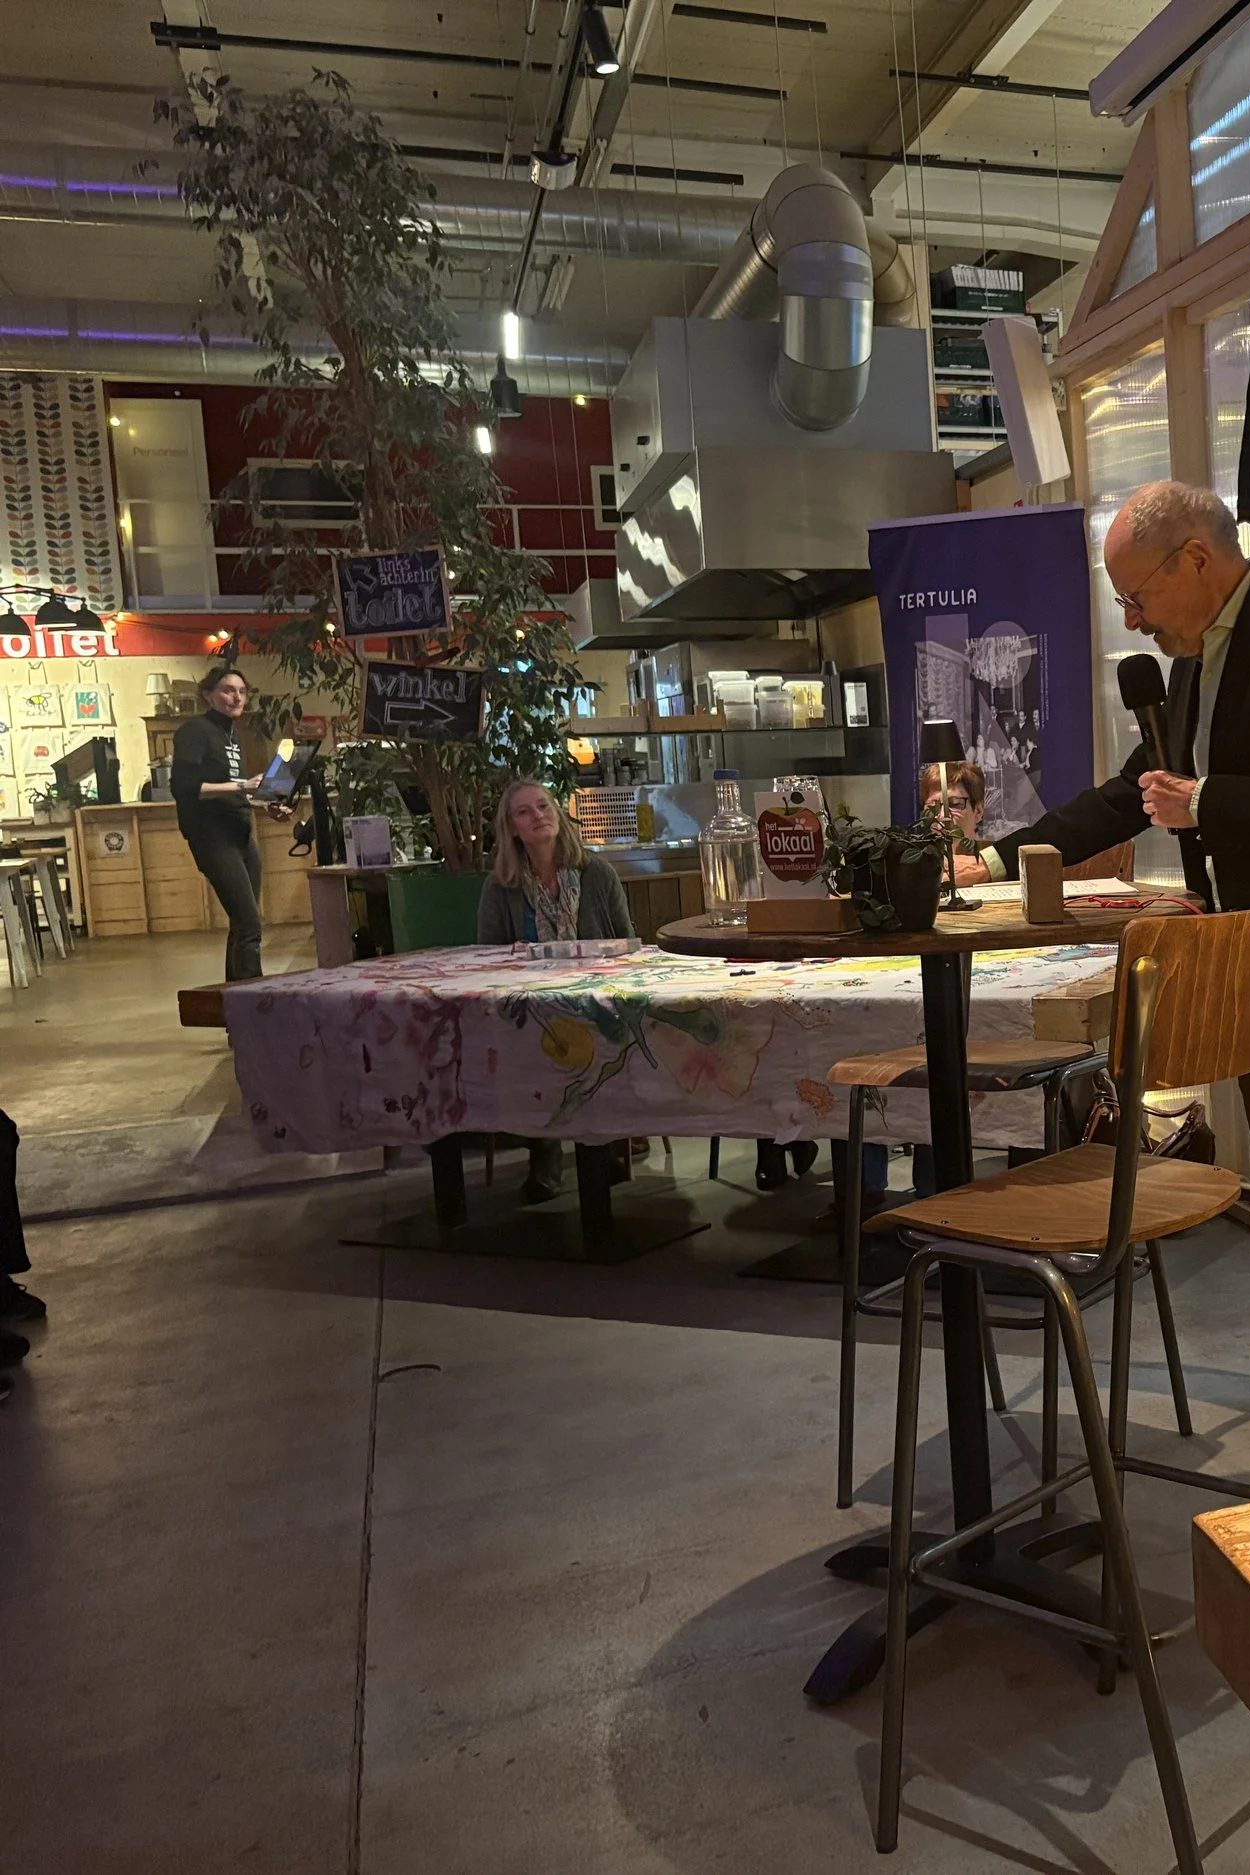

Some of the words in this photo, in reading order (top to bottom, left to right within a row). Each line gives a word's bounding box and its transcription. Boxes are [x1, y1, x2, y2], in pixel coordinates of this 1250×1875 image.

[376, 557, 411, 574] links
[344, 584, 441, 629] toilet
[899, 588, 977, 610] TERTULIA
[371, 669, 467, 703] winkel
[765, 822, 777, 831] het
[766, 831, 816, 853] lokaal
